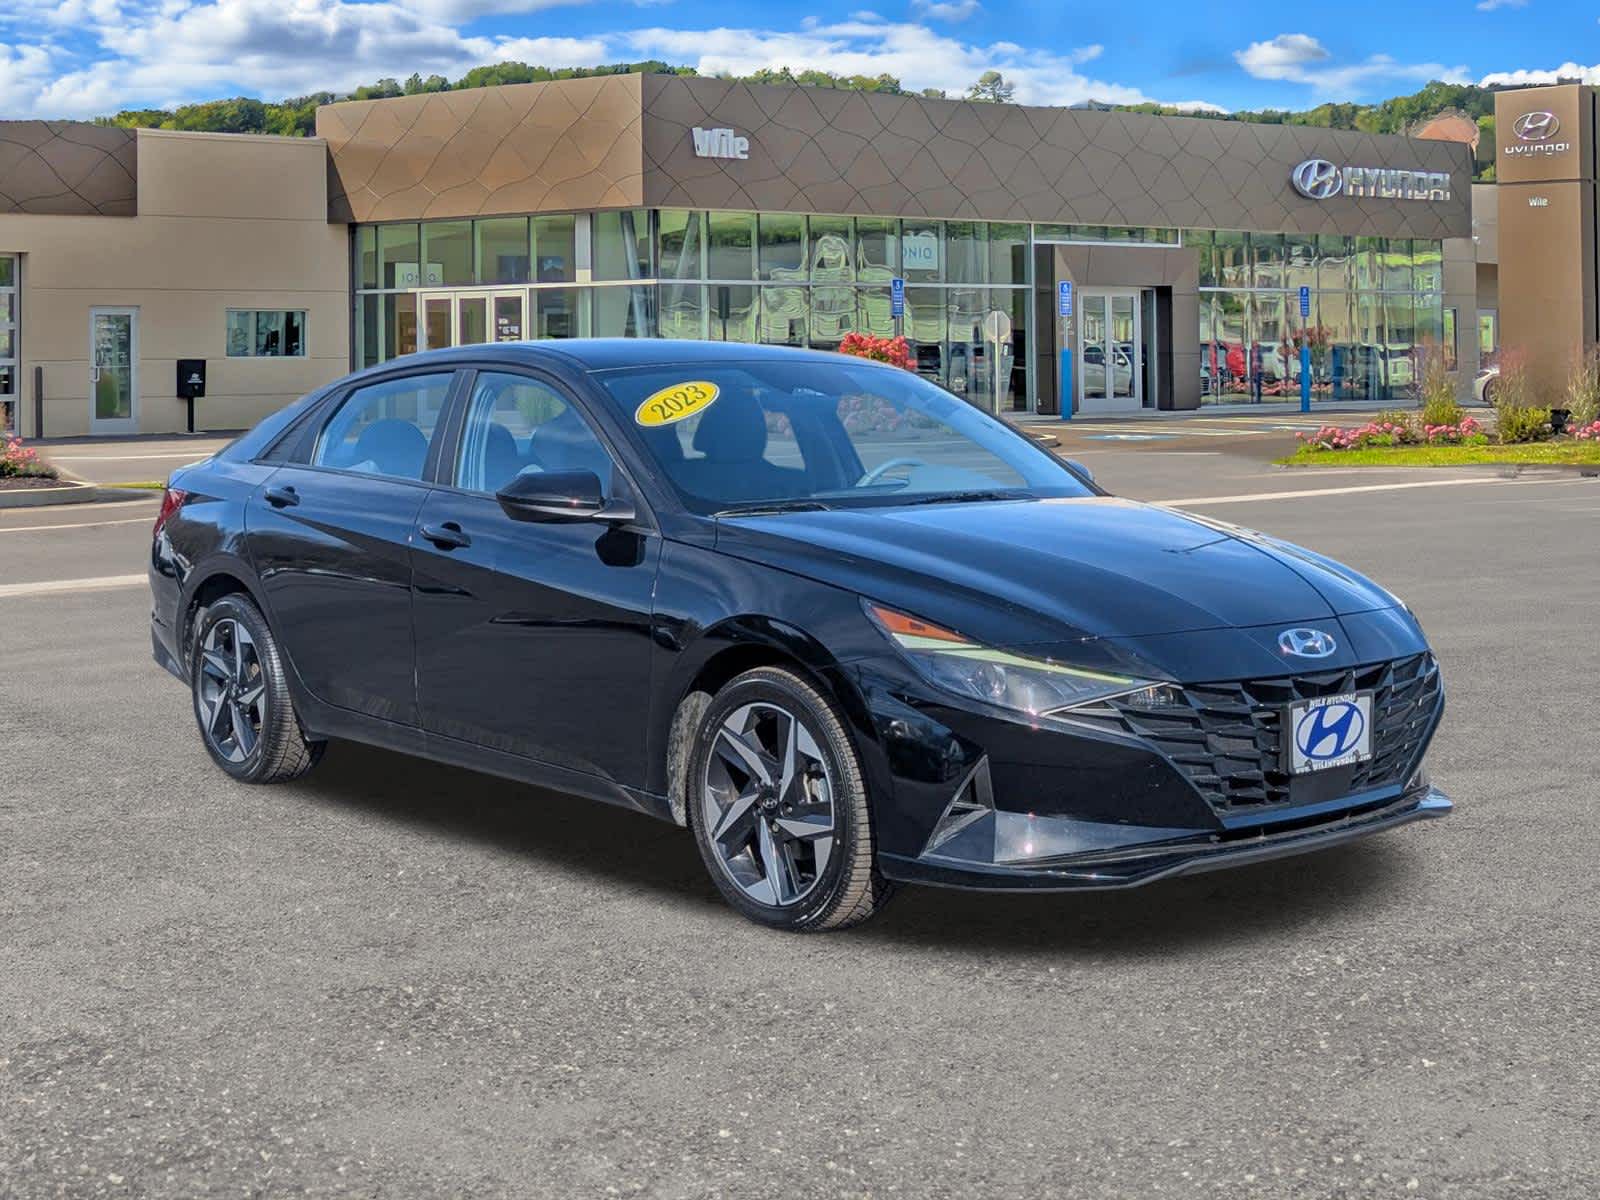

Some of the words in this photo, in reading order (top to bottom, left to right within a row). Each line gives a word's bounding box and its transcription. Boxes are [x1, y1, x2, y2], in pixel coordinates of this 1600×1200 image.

[692, 127, 749, 159] Wile
[1343, 167, 1450, 200] HYUNDAI
[1528, 197, 1548, 207] Wile
[650, 385, 707, 420] 2023
